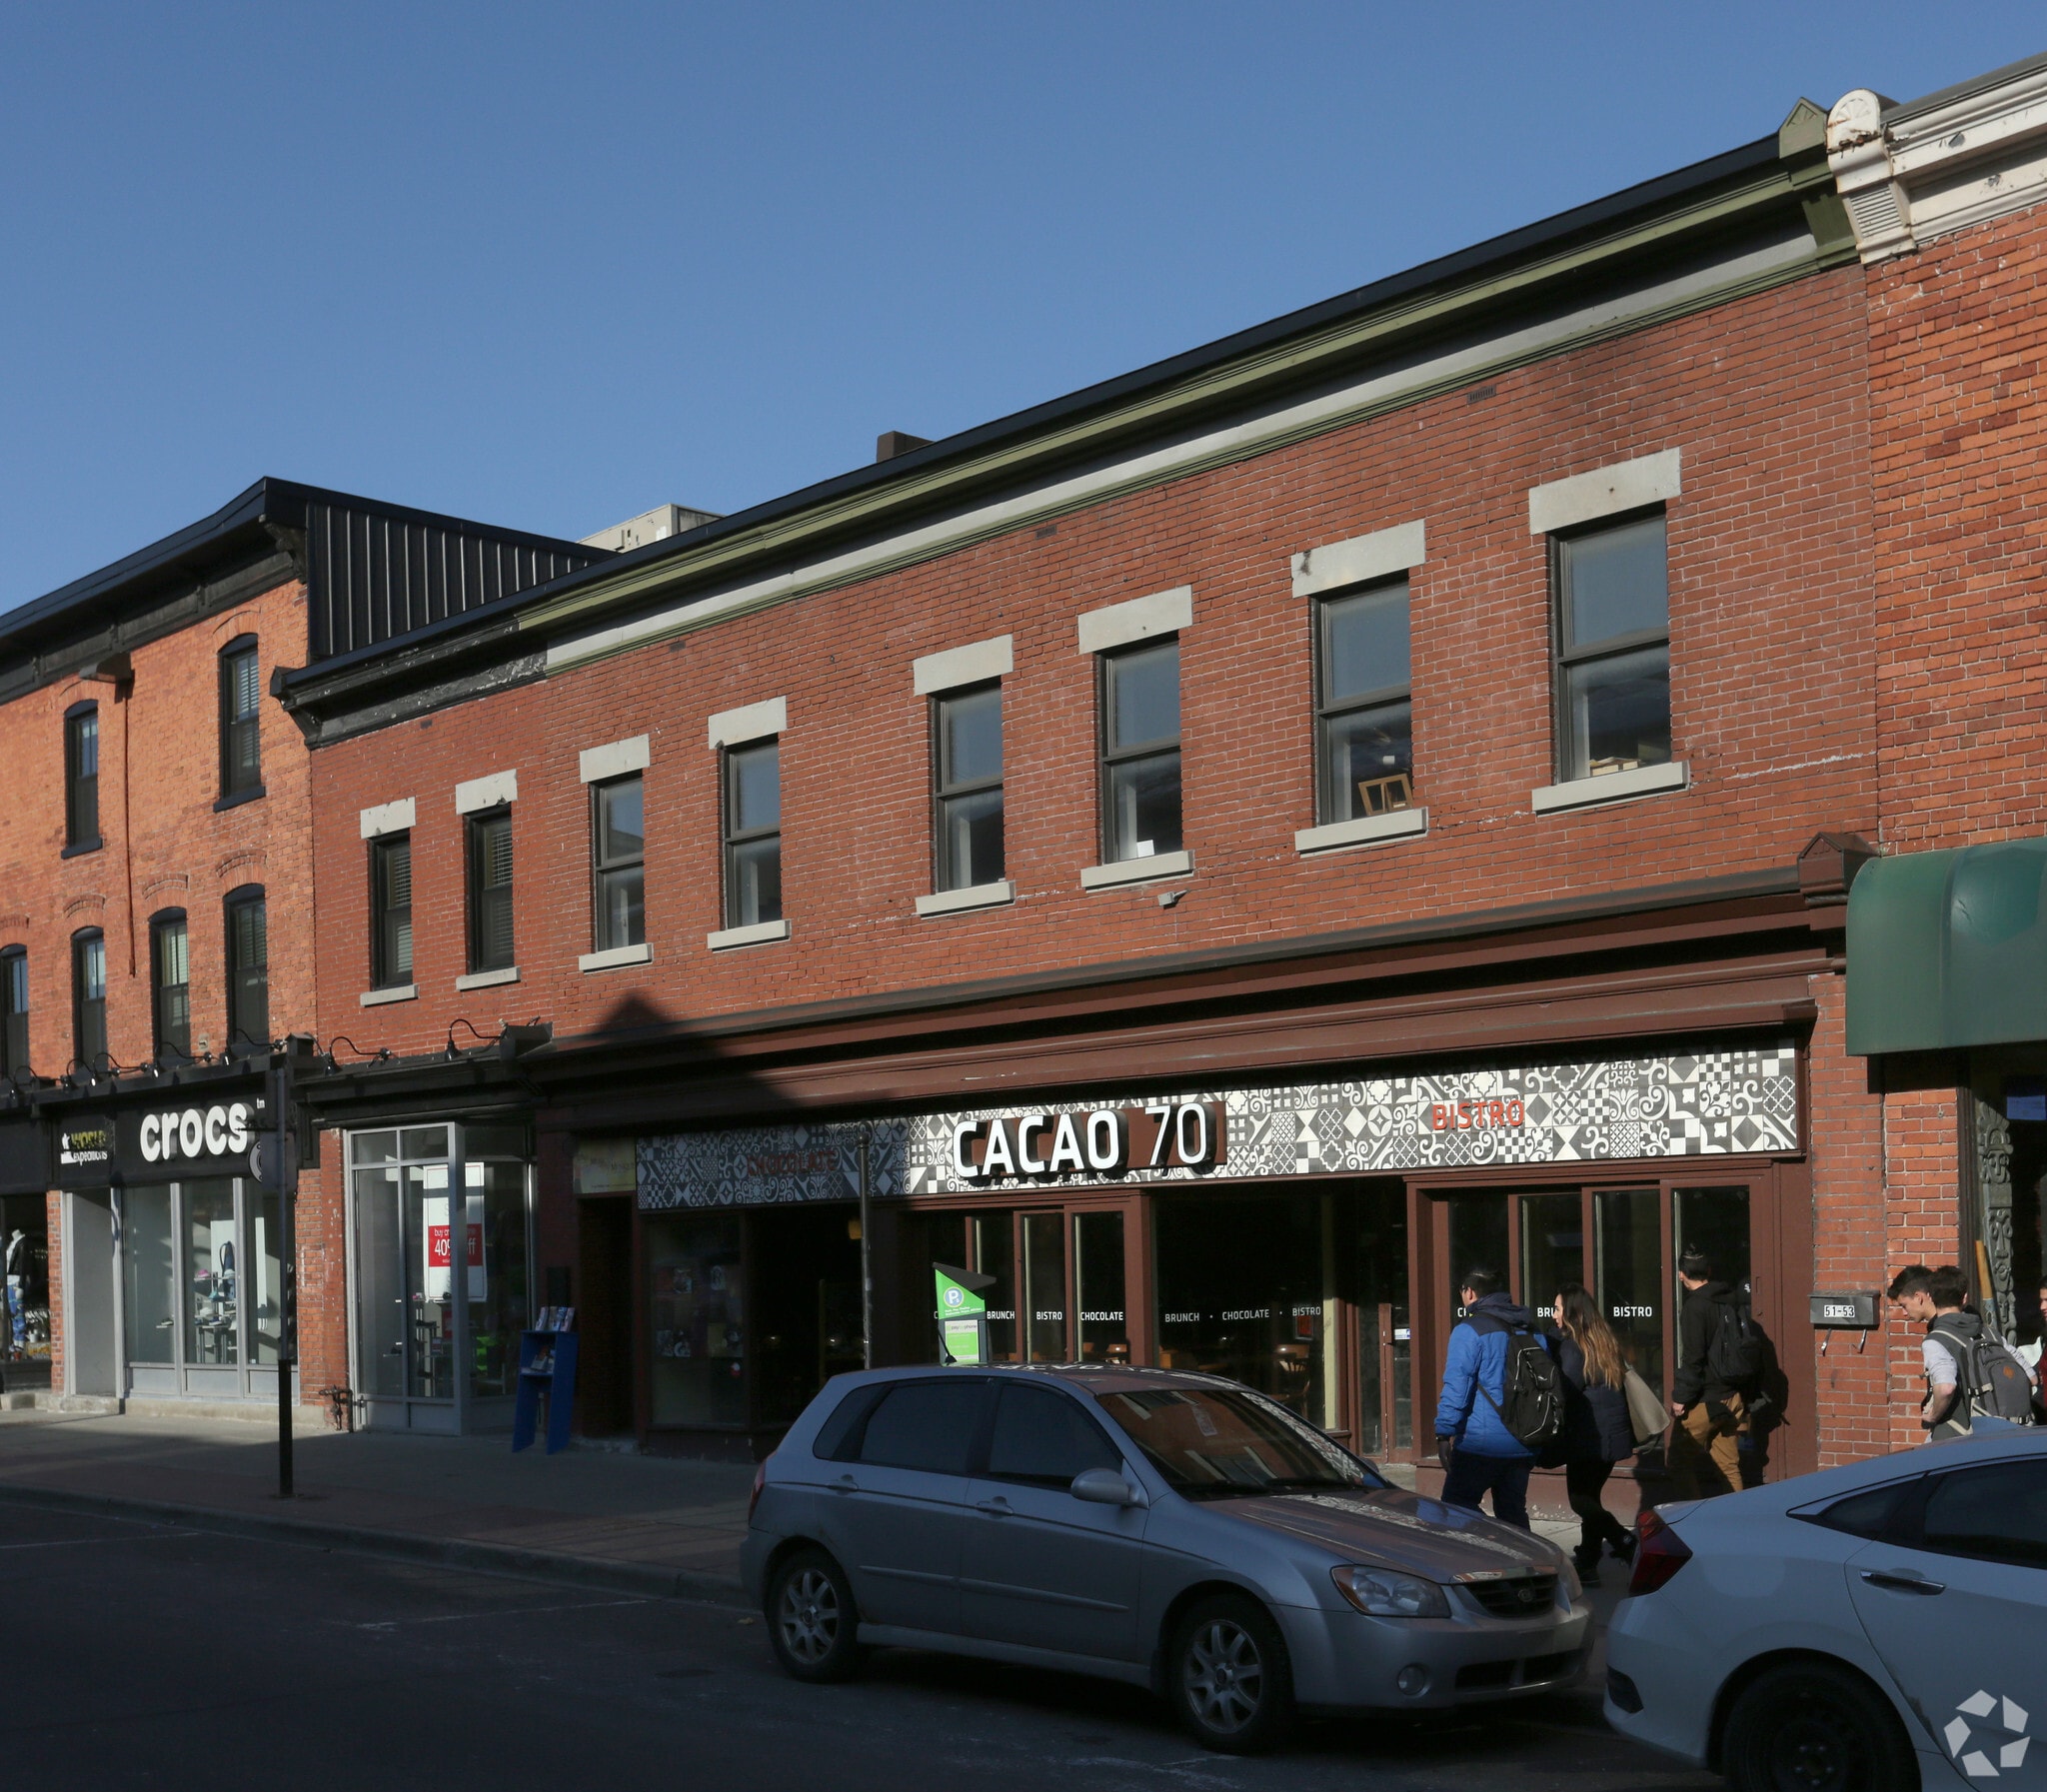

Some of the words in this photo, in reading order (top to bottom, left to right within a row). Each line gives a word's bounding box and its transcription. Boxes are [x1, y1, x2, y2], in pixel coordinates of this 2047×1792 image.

[1432, 1099, 1524, 1130] BISTRO
[140, 1102, 249, 1162] crocs
[953, 1109, 1121, 1178] CACAO
[1144, 1102, 1207, 1165] 70
[747, 1149, 837, 1176] CHOCOLATE
[987, 1310, 1016, 1320] BRUNCH
[1035, 1311, 1062, 1320] BISTRO
[1079, 1311, 1123, 1321] CHOCOLATE
[1164, 1312, 1199, 1322] BRUNCH
[1221, 1309, 1269, 1320] CHOCOLATE
[1291, 1306, 1321, 1317] BISTRO
[1613, 1306, 1652, 1317] BISTRO
[1825, 1305, 1854, 1316] 51-53
